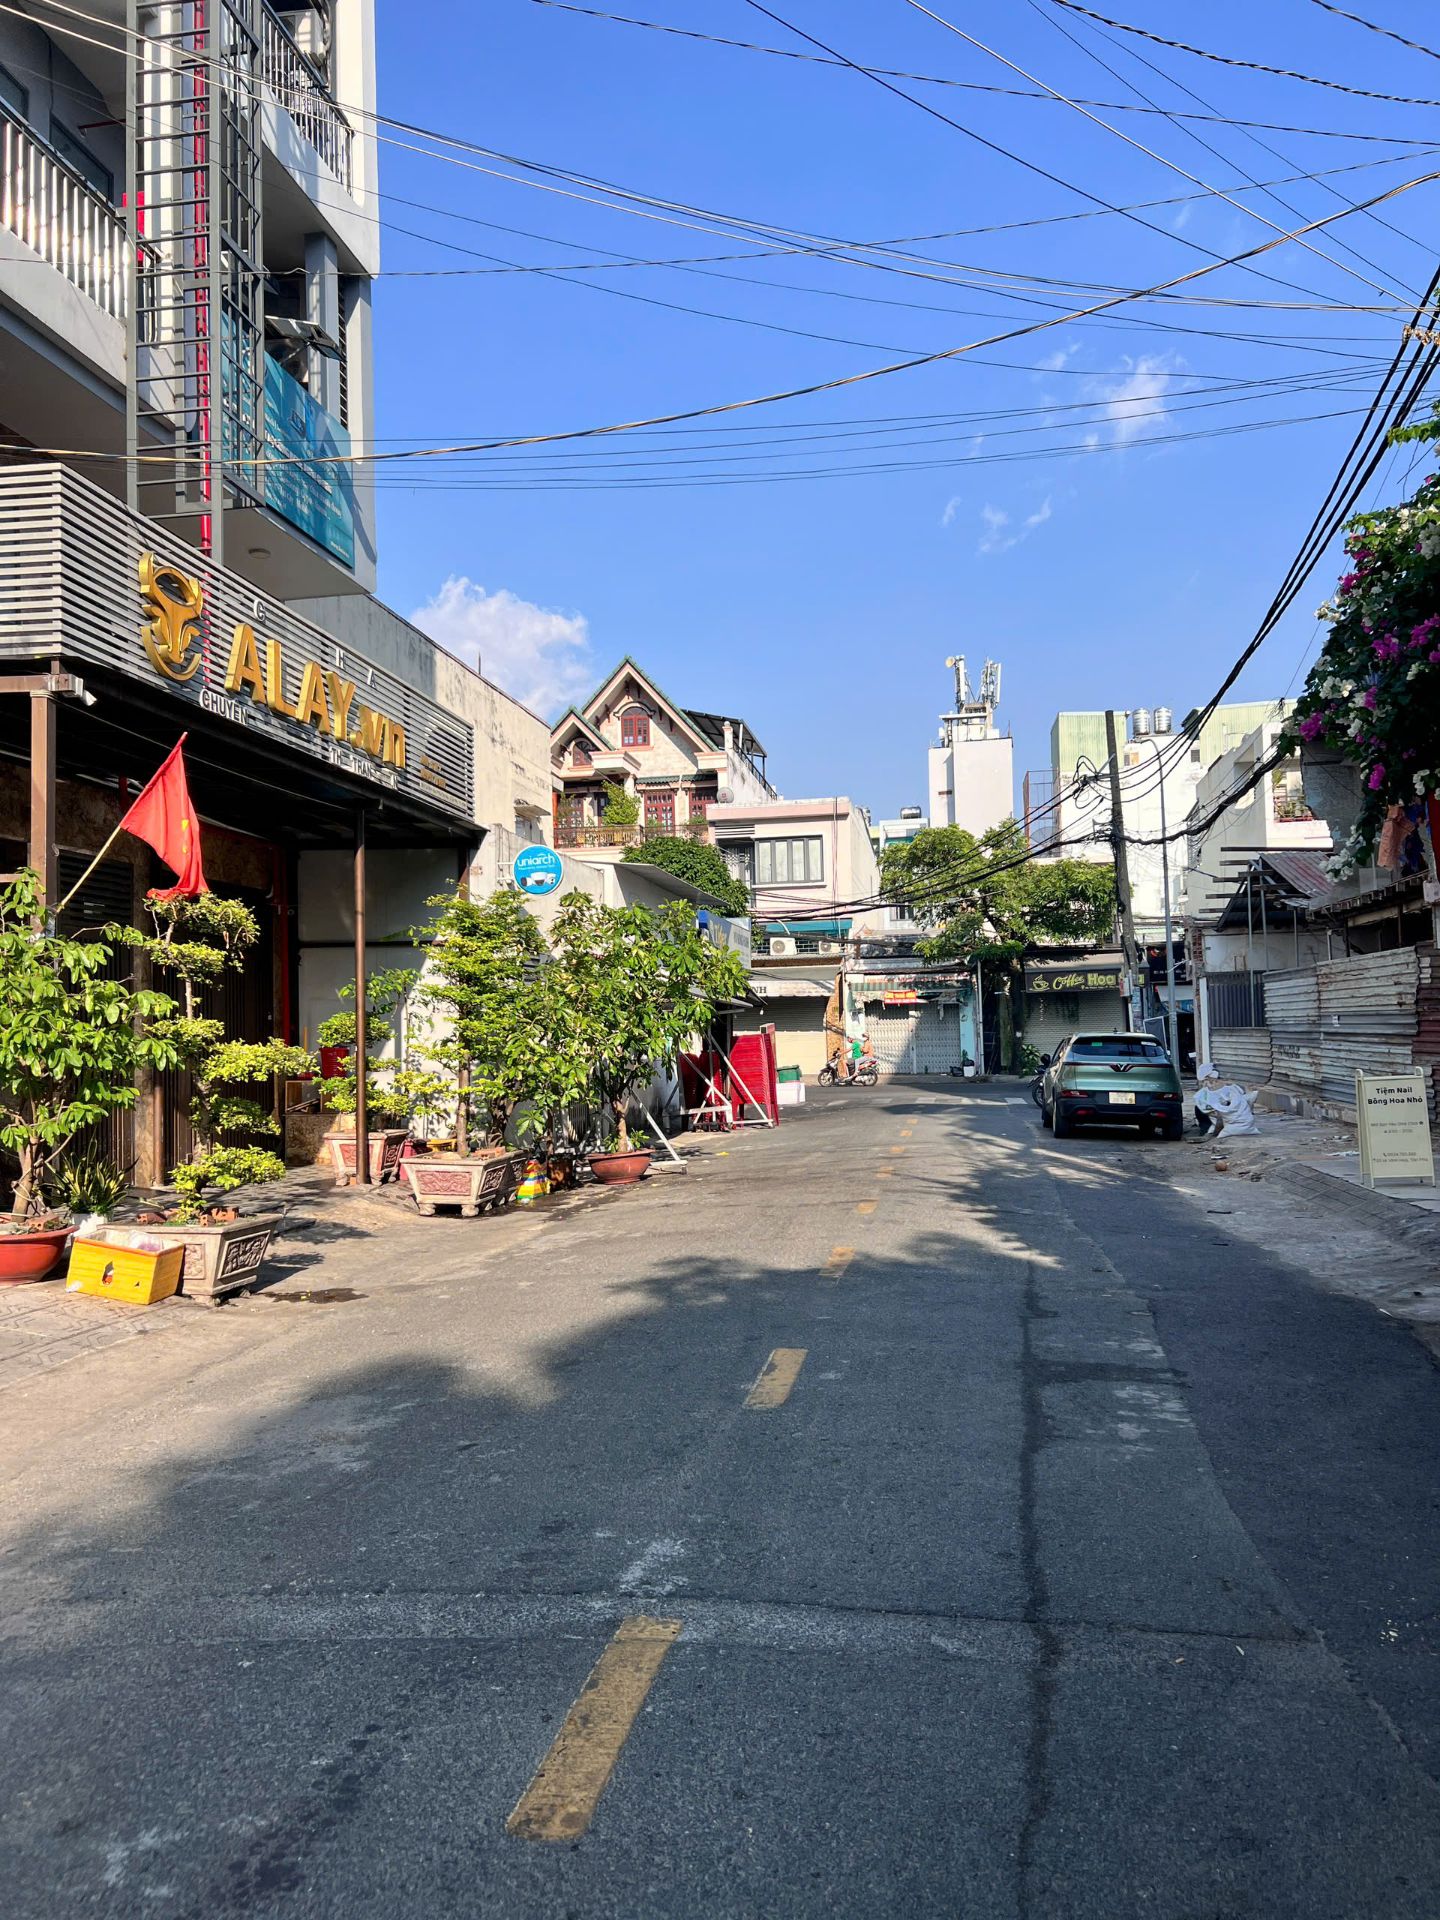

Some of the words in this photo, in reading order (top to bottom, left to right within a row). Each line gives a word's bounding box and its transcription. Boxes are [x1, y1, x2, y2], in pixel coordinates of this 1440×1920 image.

[517, 854, 555, 867] uniarch
[1053, 974, 1084, 989] Coffee
[1088, 973, 1116, 986] Hoa
[1376, 1087, 1395, 1095] Tiệm
